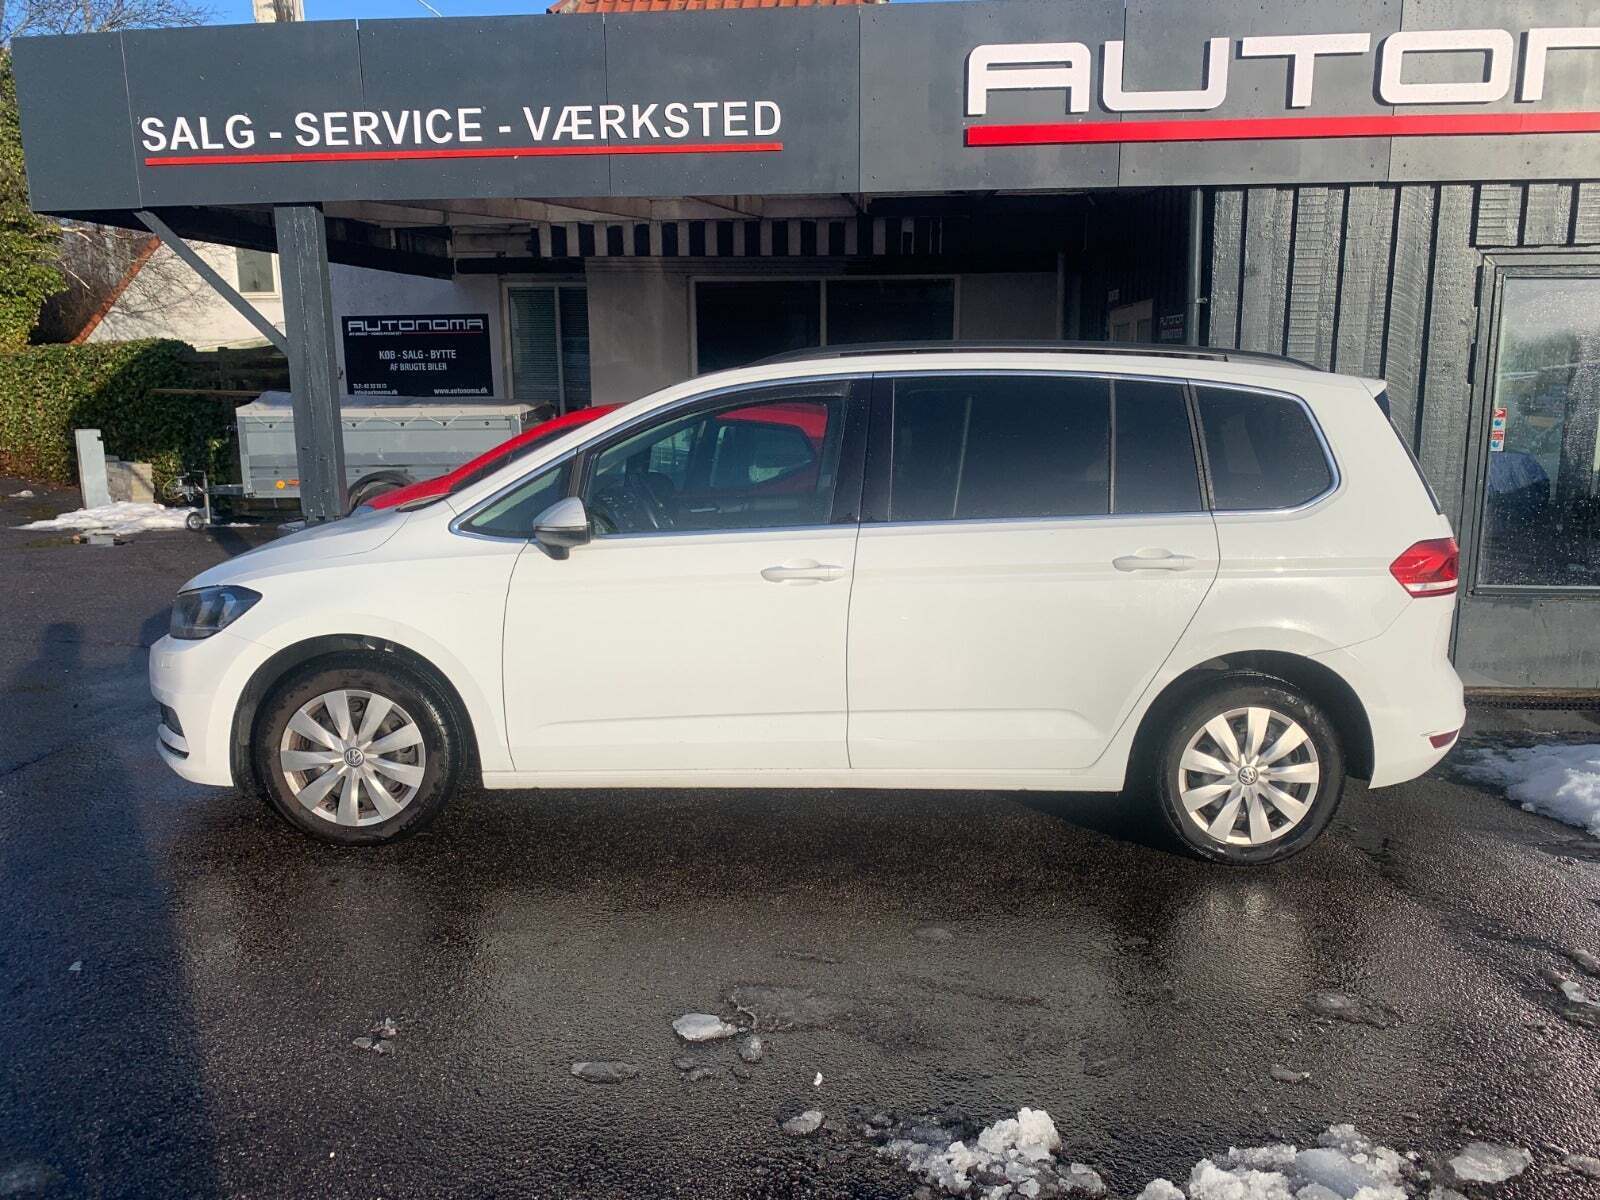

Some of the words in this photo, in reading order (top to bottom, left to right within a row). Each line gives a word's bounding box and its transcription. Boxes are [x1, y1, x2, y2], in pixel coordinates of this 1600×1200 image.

[141, 113, 256, 152] SALG
[294, 107, 483, 147] SERVICE
[522, 100, 782, 141] VÆRKSTED
[347, 318, 484, 332] AUTONOMA
[378, 349, 396, 360] KØB
[402, 349, 424, 360] SALG
[430, 349, 457, 359] BYTTE
[389, 362, 399, 371] AF
[399, 362, 427, 371] BRUGTE
[427, 362, 447, 371] BILER
[433, 386, 488, 395] www.autonoma.dk
